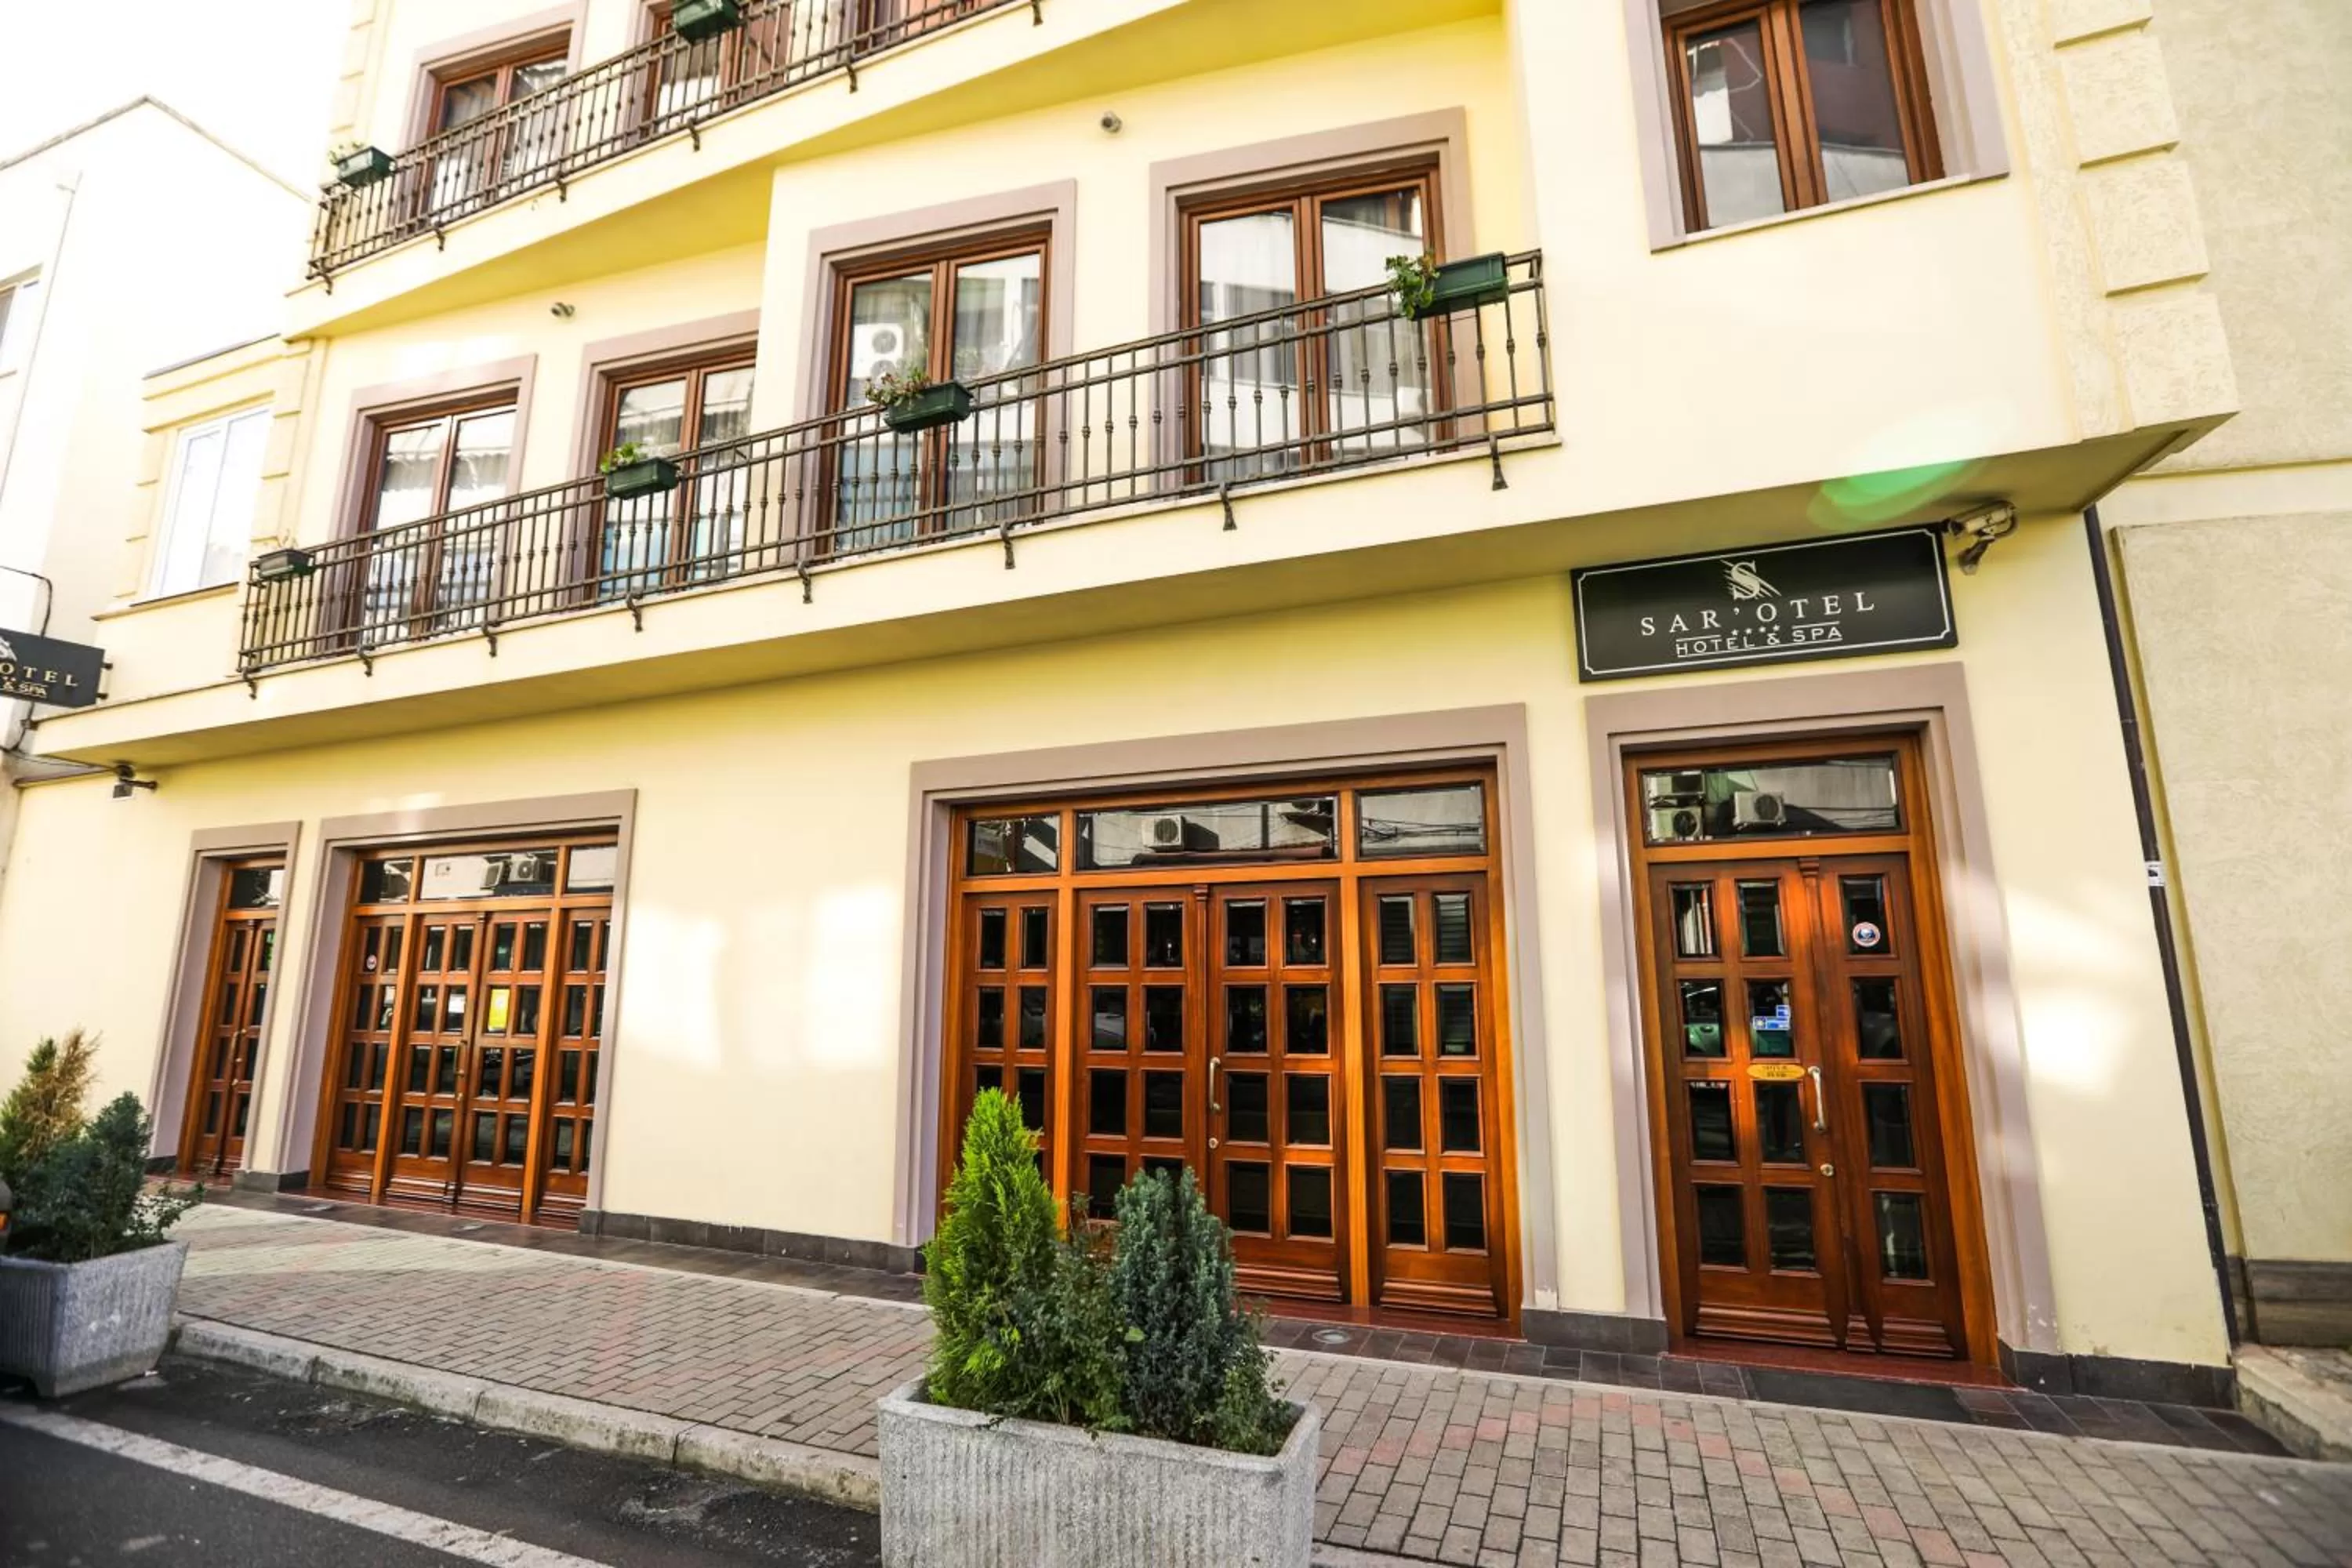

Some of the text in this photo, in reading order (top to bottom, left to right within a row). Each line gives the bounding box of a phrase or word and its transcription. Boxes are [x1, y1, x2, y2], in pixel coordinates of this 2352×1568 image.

[1675, 627, 1842, 655] HOTEL & SPA
